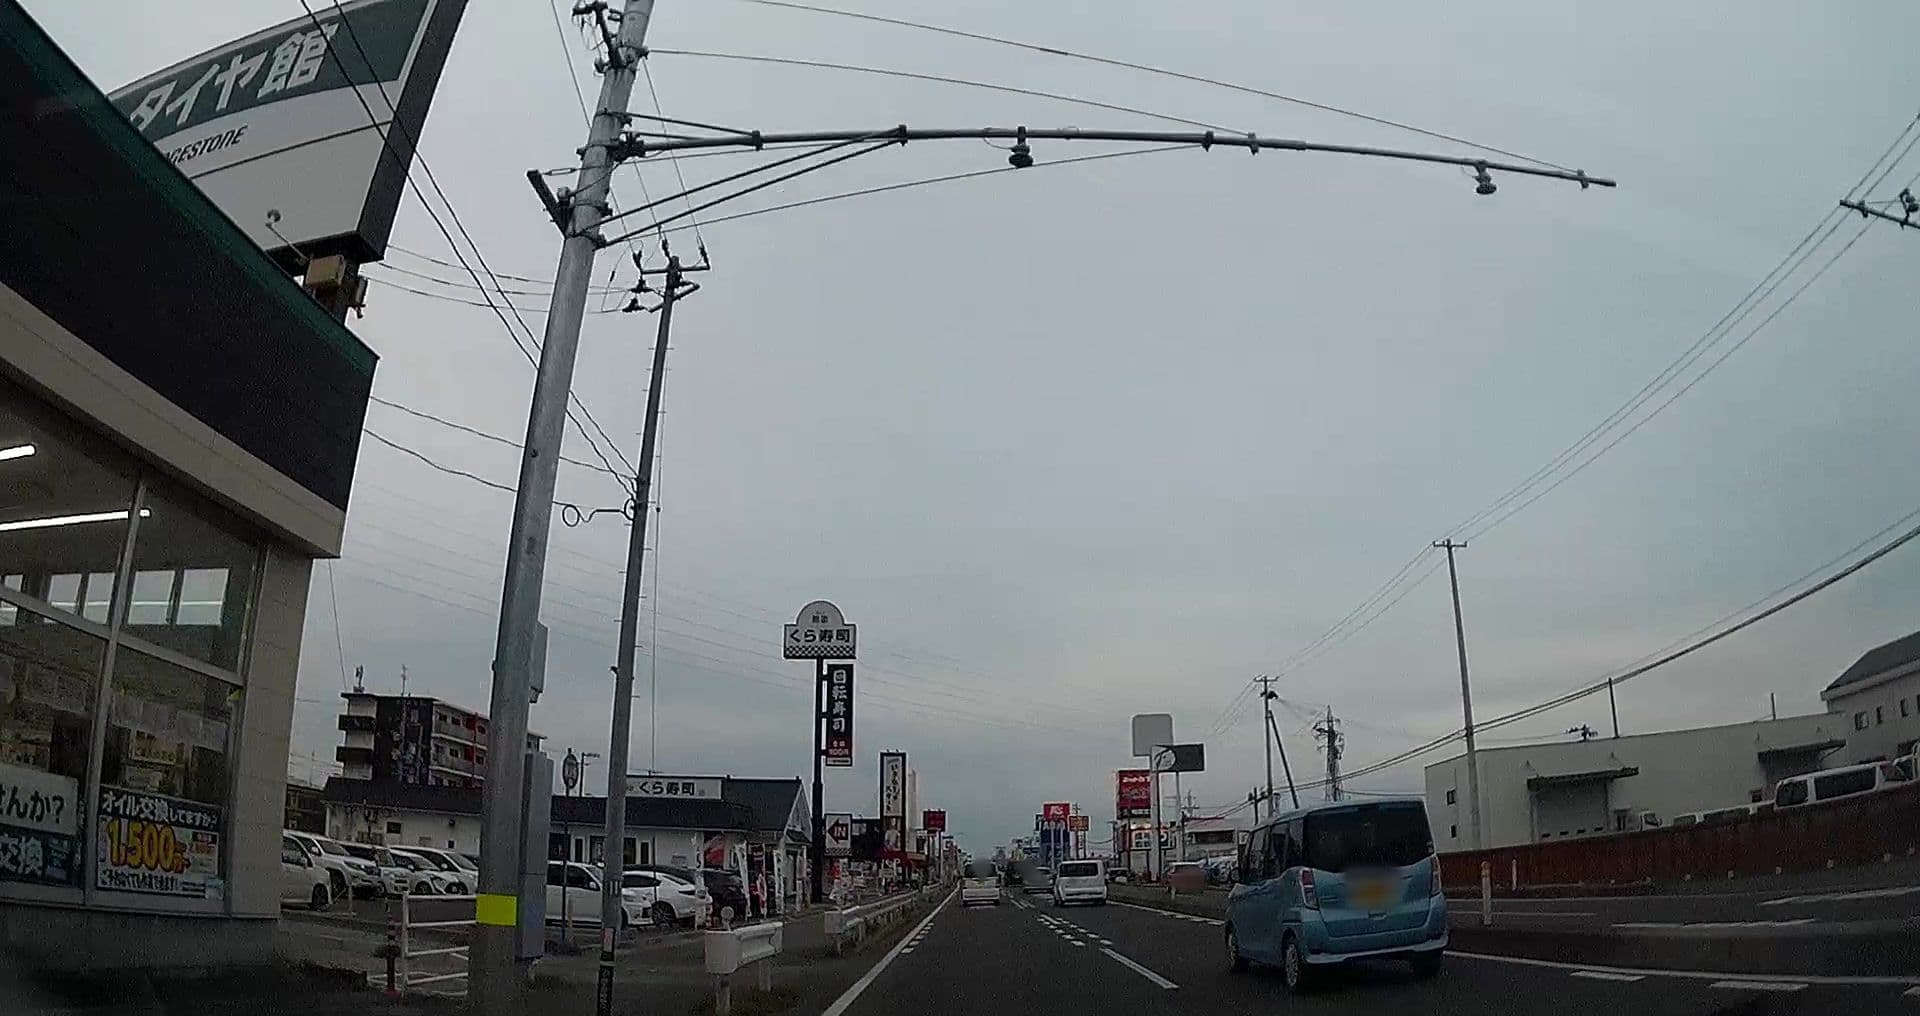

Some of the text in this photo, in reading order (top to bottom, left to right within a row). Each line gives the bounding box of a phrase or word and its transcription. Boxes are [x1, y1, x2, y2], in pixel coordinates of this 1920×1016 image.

[130, 23, 338, 132] タイヤ館
[789, 628, 851, 643] くら寿司
[831, 669, 847, 733] 回転寿司
[639, 780, 696, 796] くら寿司
[834, 826, 847, 836] IN
